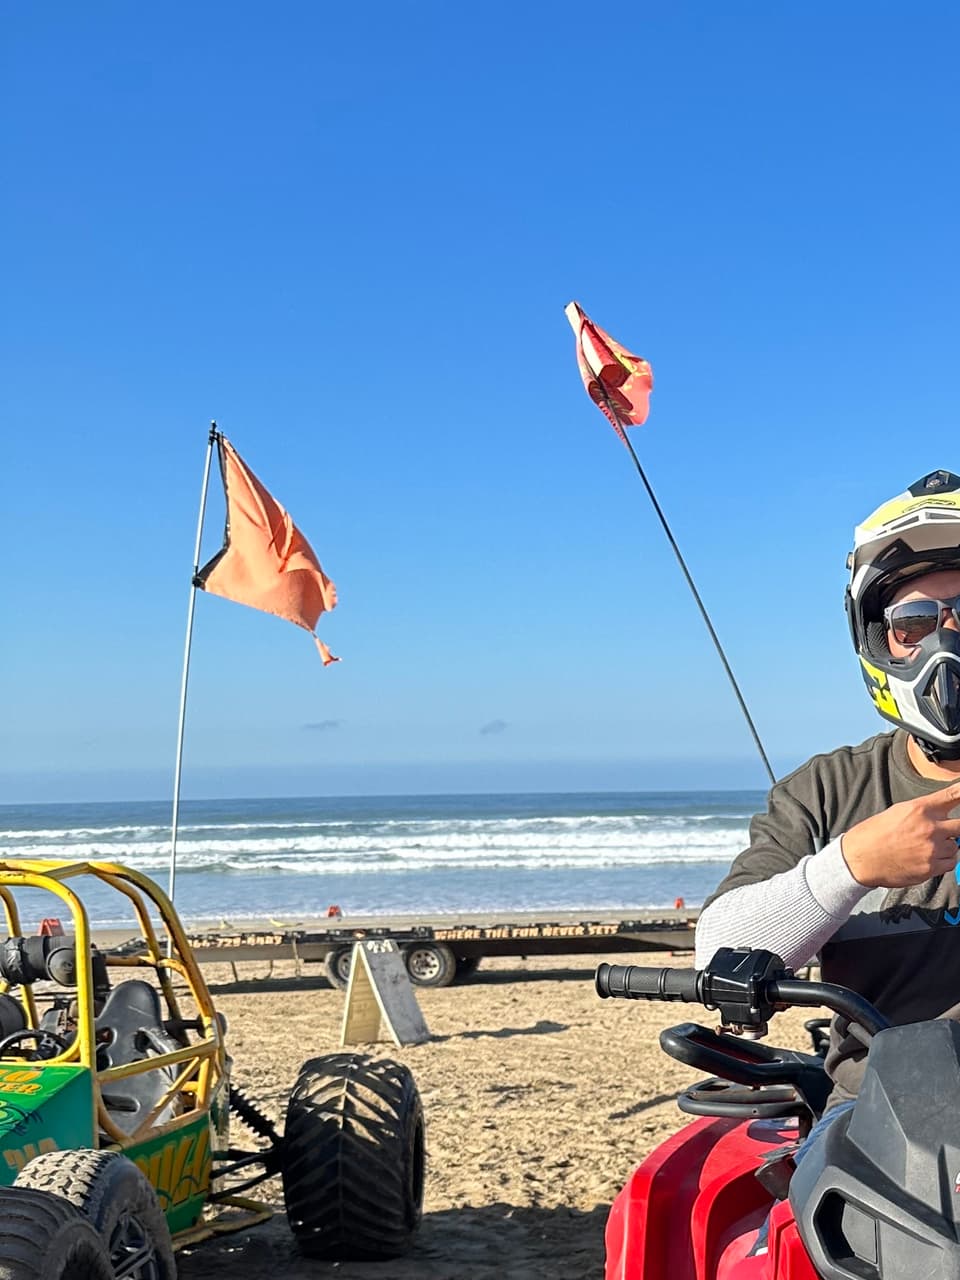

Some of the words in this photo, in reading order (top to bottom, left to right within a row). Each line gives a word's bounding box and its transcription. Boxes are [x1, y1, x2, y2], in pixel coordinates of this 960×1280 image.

[434, 929, 481, 940] WHERE
[485, 928, 508, 939] THE
[512, 927, 539, 938] FUN
[543, 926, 585, 937] NEVER
[588, 925, 620, 936] SETS
